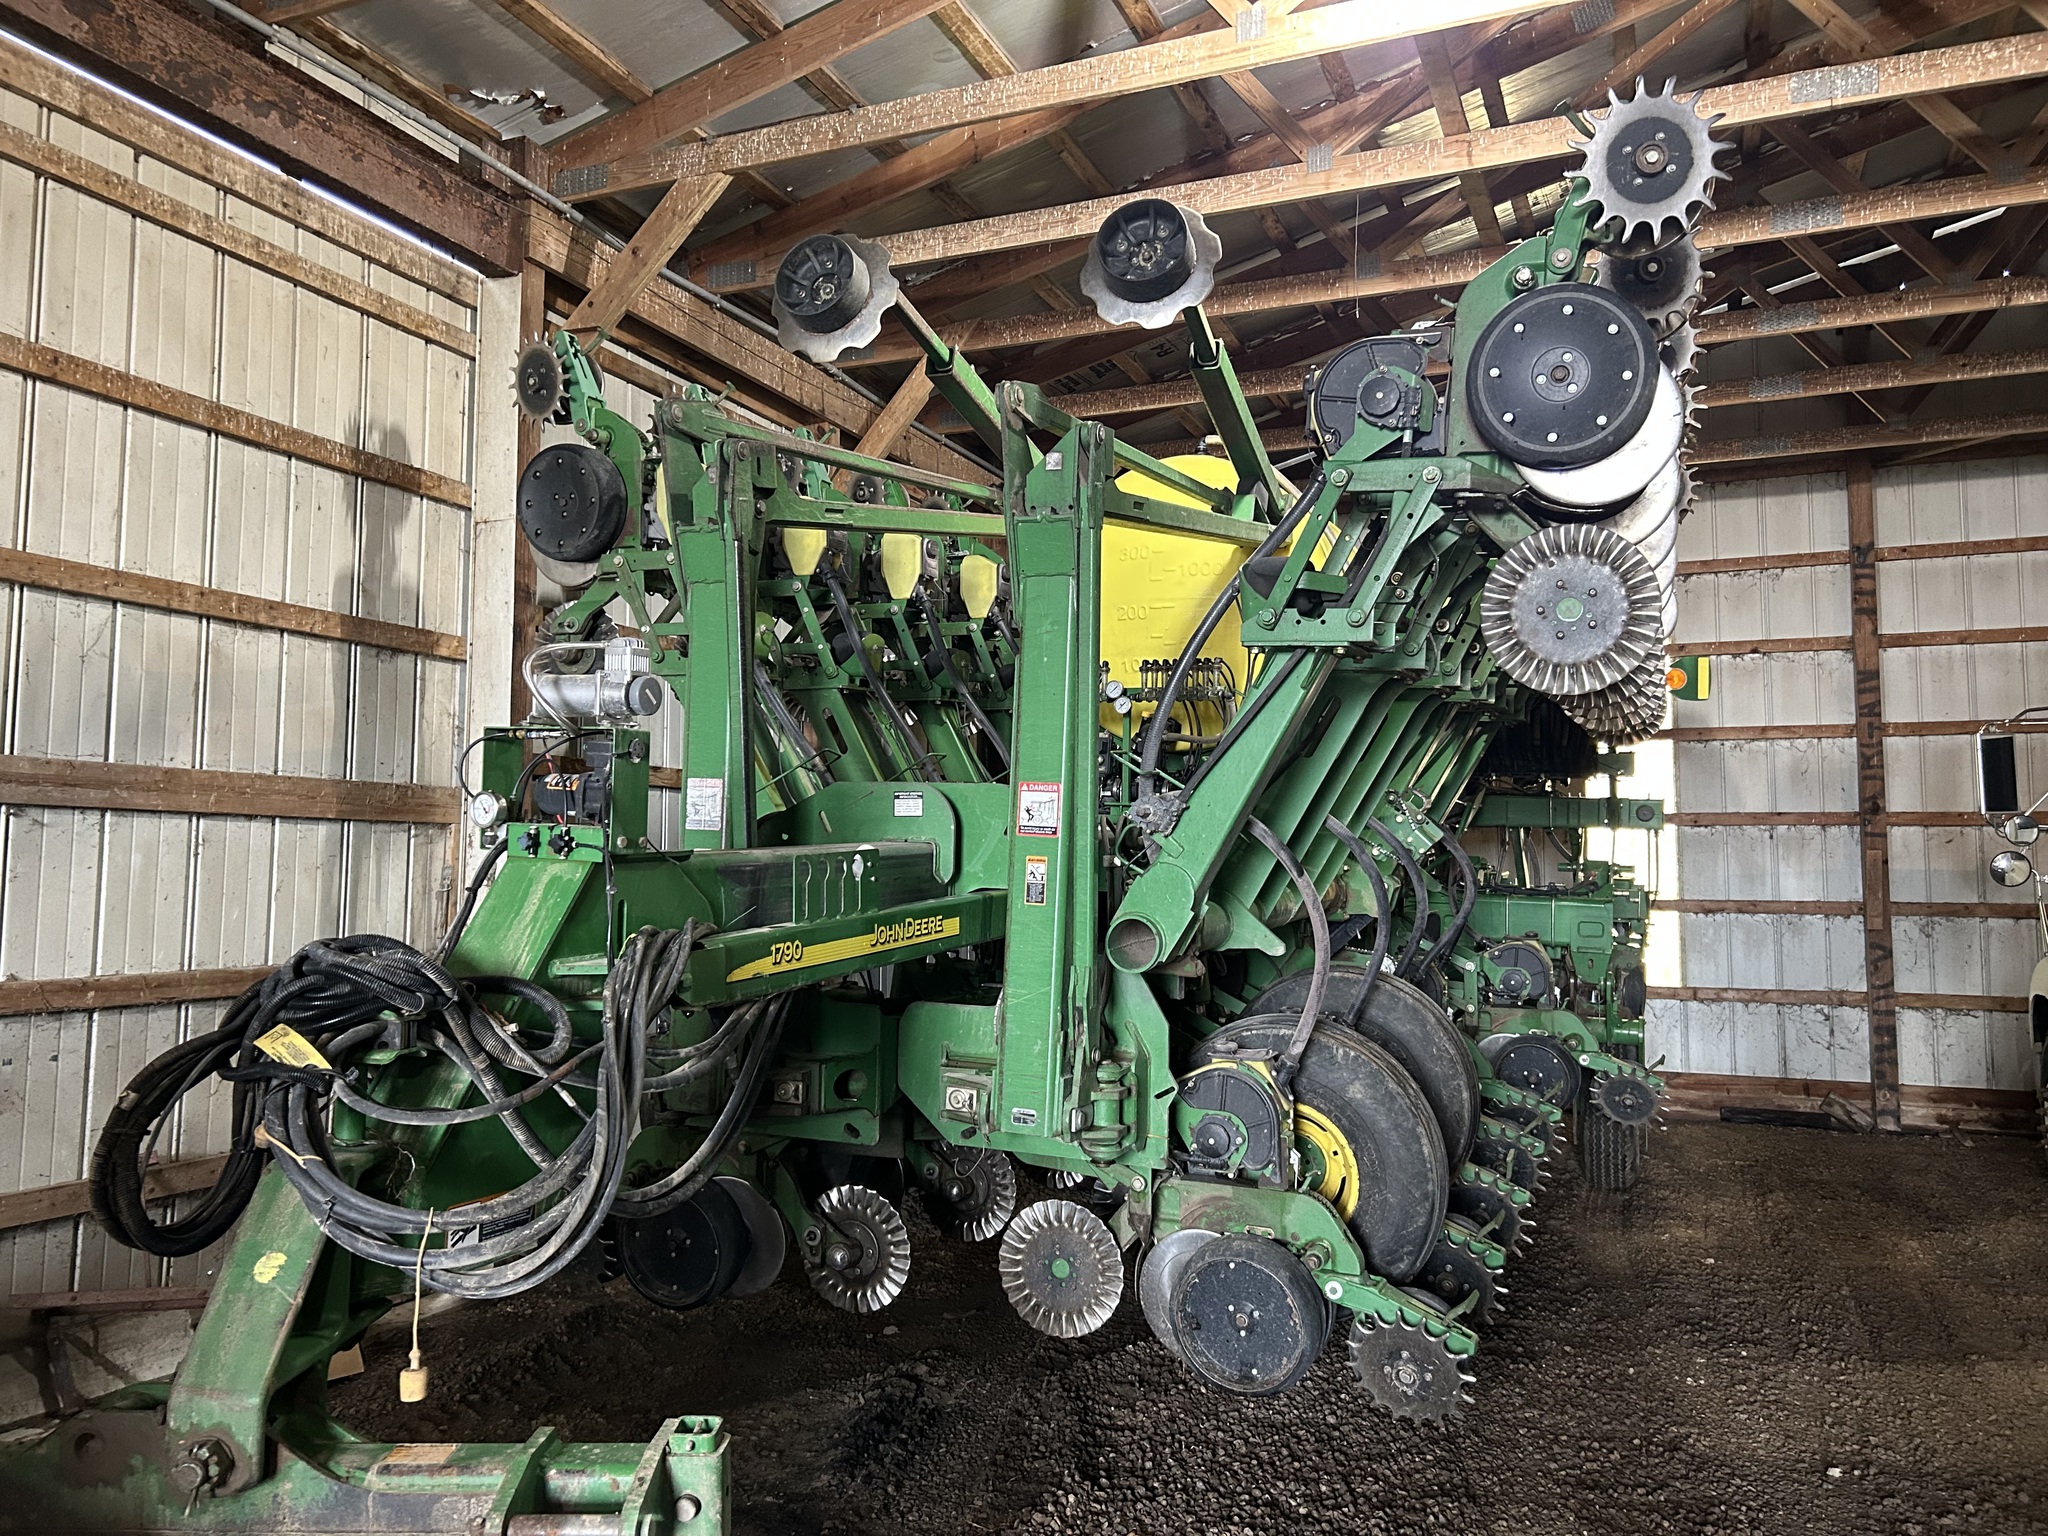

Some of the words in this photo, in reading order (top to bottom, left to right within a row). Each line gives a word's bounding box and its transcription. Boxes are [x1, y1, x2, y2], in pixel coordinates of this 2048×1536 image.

[1119, 546, 1150, 561] 300
[1178, 562, 1225, 577] 1000
[1117, 605, 1148, 621] 200
[1121, 658, 1140, 673] 10
[1029, 784, 1058, 792] DANGER
[870, 923, 905, 947] JOHN
[904, 915, 943, 940] DEERE
[771, 940, 803, 965] 1790
